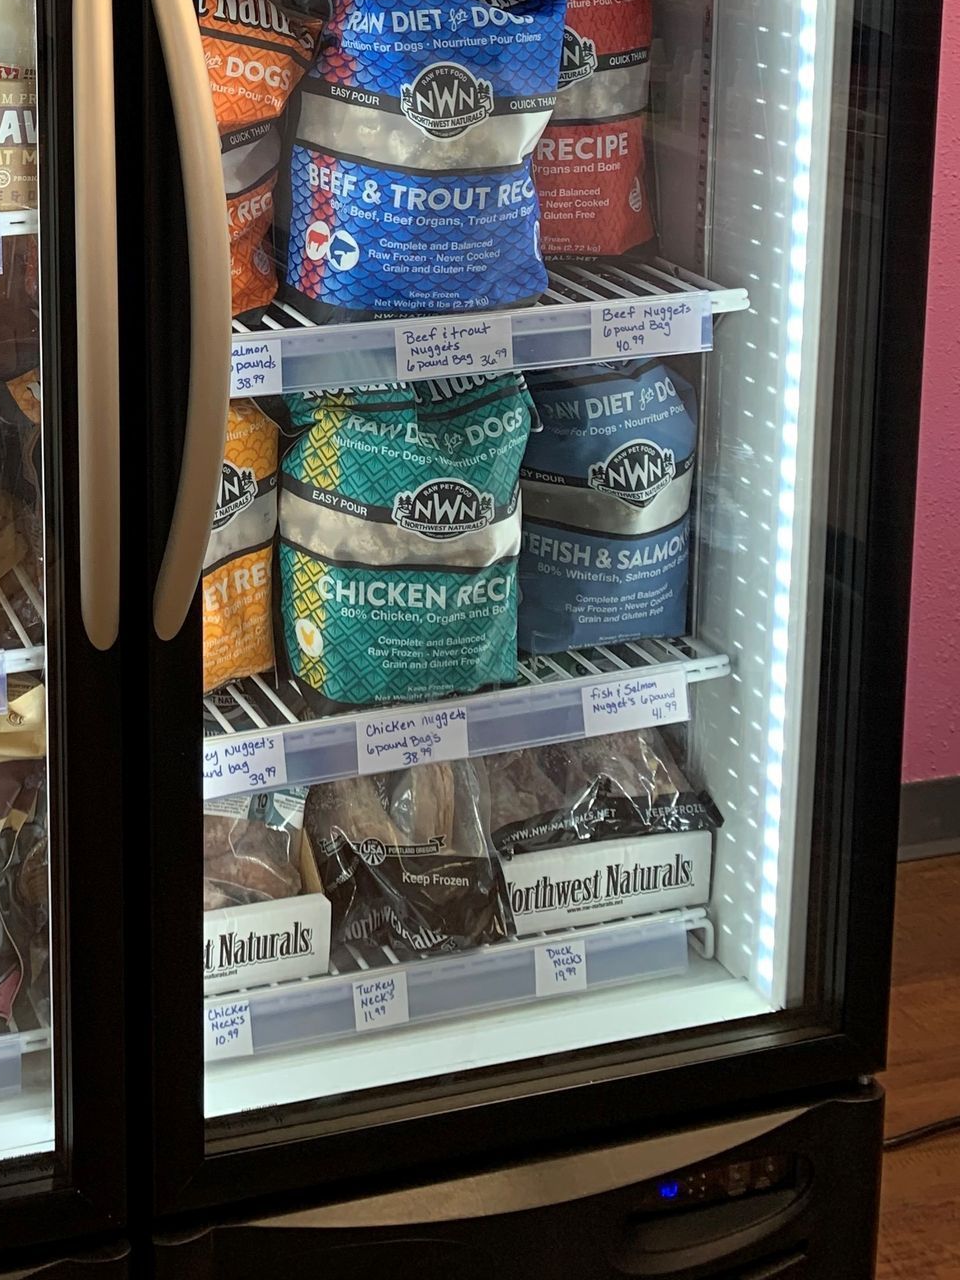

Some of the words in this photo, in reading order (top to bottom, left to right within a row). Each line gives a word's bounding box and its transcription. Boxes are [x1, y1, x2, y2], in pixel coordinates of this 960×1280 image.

[392, 8, 442, 33] DIET
[537, 131, 629, 162] RECIPE
[390, 186, 491, 211] TROUT
[602, 305, 636, 322] Beef
[643, 302, 692, 321] Nuggets
[403, 327, 437, 344] Beef
[451, 322, 491, 340] trout
[649, 320, 672, 337] Bag
[410, 341, 461, 359] Nuggets
[451, 353, 474, 366] Bag
[236, 374, 266, 391] 38.99
[317, 574, 447, 612] CHICKEN
[624, 681, 658, 696] Salmon
[366, 720, 416, 738] Chicken
[228, 761, 250, 775] bag
[402, 872, 430, 887] Keep
[433, 873, 470, 888] Frozen
[605, 853, 693, 899] Naturals
[218, 921, 314, 969] Naturals
[546, 945, 574, 959] Duck
[355, 979, 396, 996] Turkey
[215, 1028, 240, 1046] 10.99
